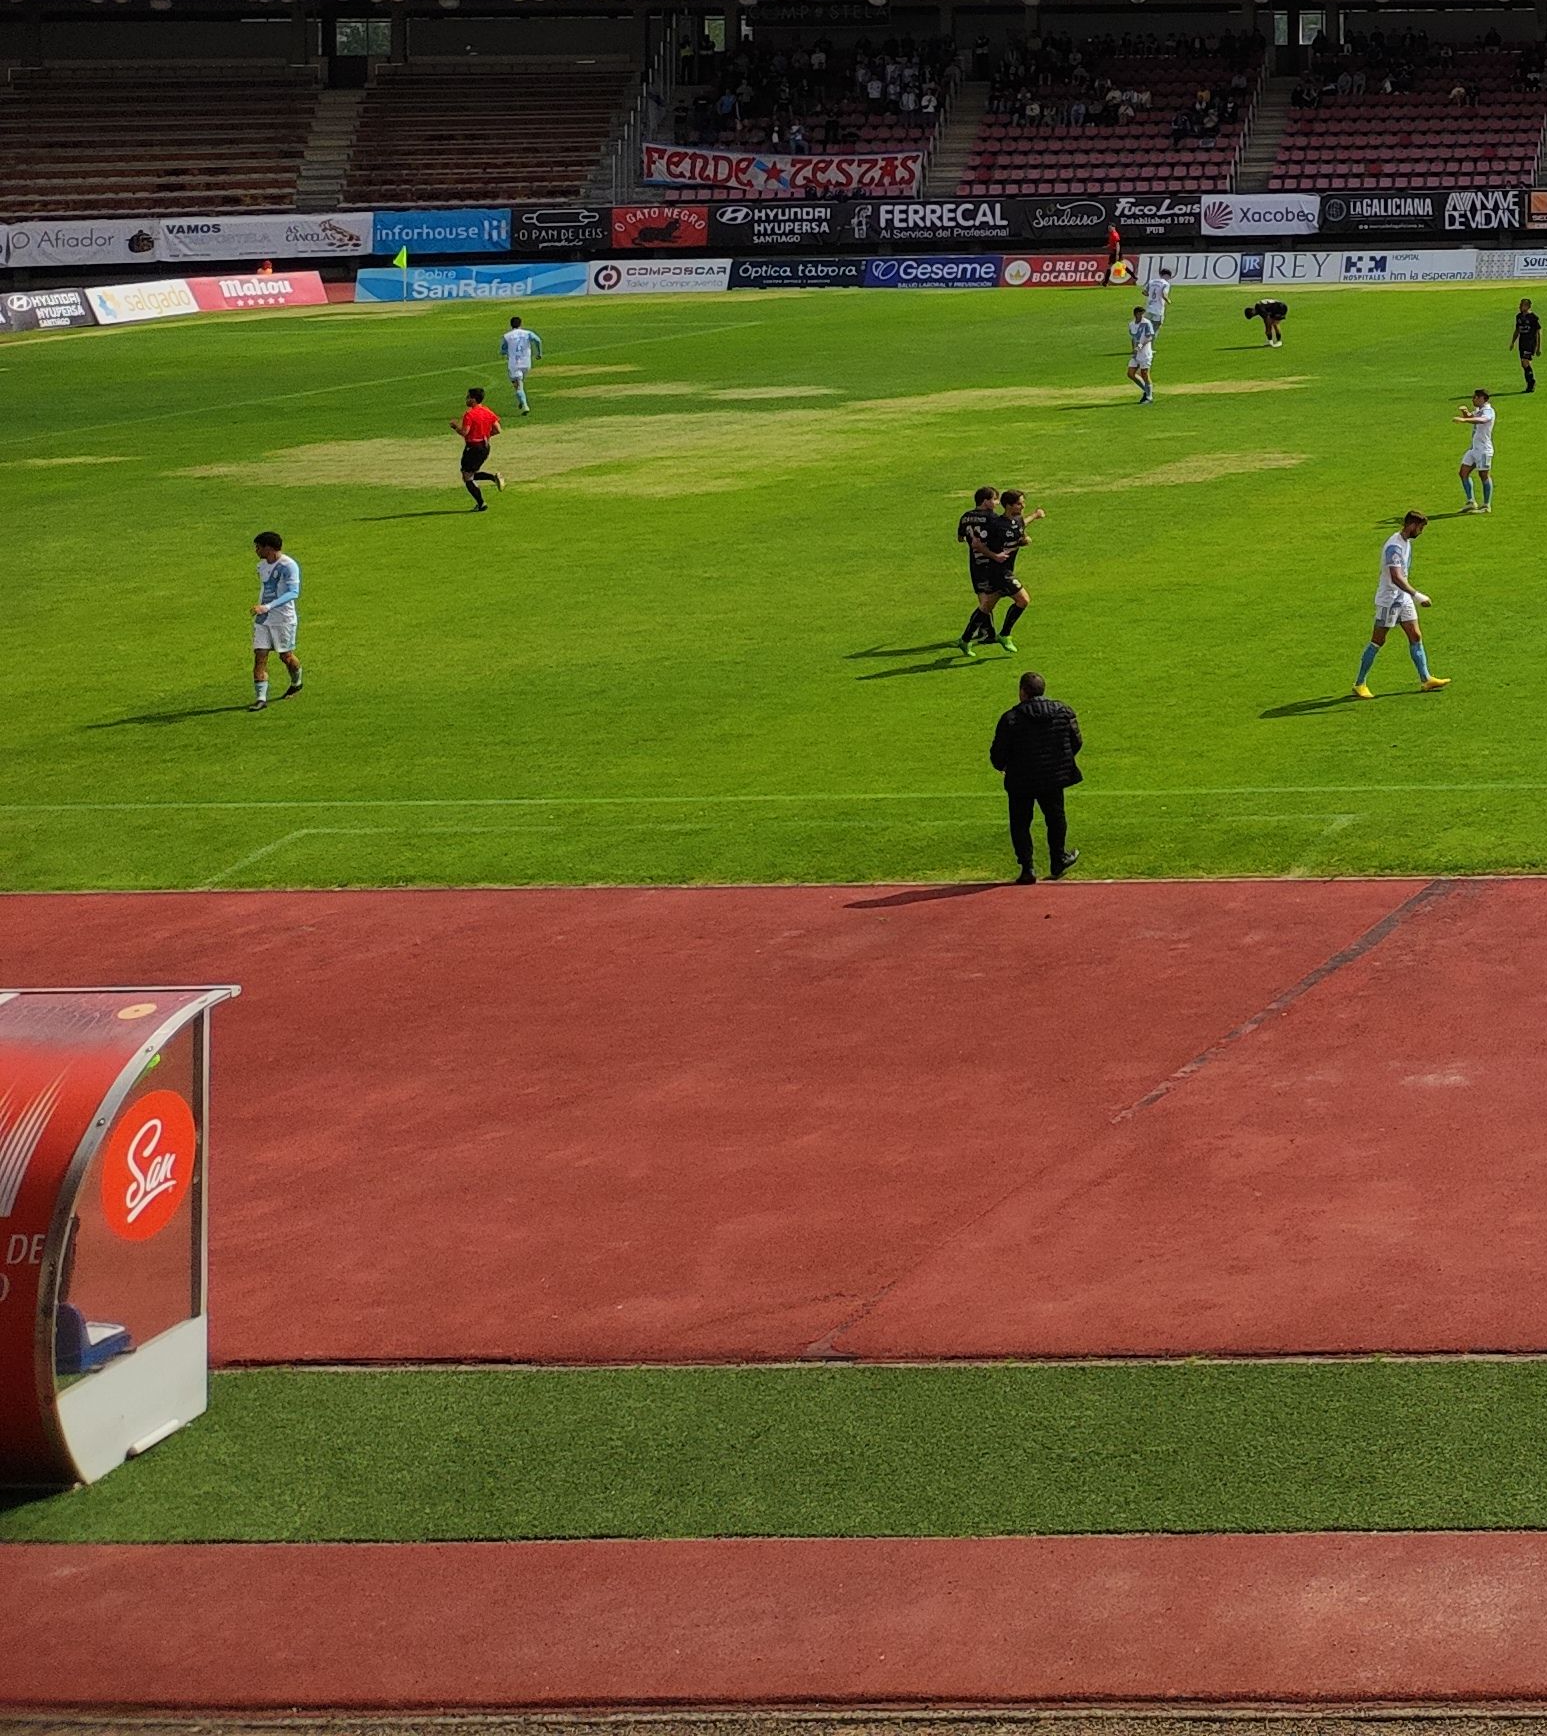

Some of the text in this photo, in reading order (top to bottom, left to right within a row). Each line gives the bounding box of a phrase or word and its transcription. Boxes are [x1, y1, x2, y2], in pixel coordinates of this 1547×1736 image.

[614, 207, 706, 232] O GATO NEGRO
[753, 208, 830, 220] HYUNDAI
[880, 203, 1008, 227] FERRECAL
[1174, 216, 1195, 224] 1979
[166, 224, 221, 234] VAMOS
[286, 226, 300, 235] AS
[376, 224, 478, 241] inforhouse
[531, 228, 603, 241] PAN DE LEIS
[753, 222, 830, 235] HYUPERSA
[893, 227, 1010, 239] Servicio del Profesional
[1146, 226, 1165, 234] PUB
[11, 228, 114, 249] O Afiador
[753, 235, 801, 244] SANTIAGO
[626, 266, 728, 277] COMPOSCAR
[739, 262, 792, 279] Óptica
[900, 260, 996, 279] Geseme
[1043, 261, 1098, 272] O REI DO
[1268, 254, 1331, 278] REY
[413, 268, 456, 280] Cobre
[1032, 271, 1104, 282] BOCADILLO
[1390, 269, 1474, 282] hm la esperanza
[218, 277, 292, 297] Mahou
[412, 277, 534, 298] SanRafael
[626, 279, 648, 289] Taller
[31, 292, 80, 308] HYUNDAI
[124, 284, 191, 315] salgado
[6, 1233, 46, 1265] DE
